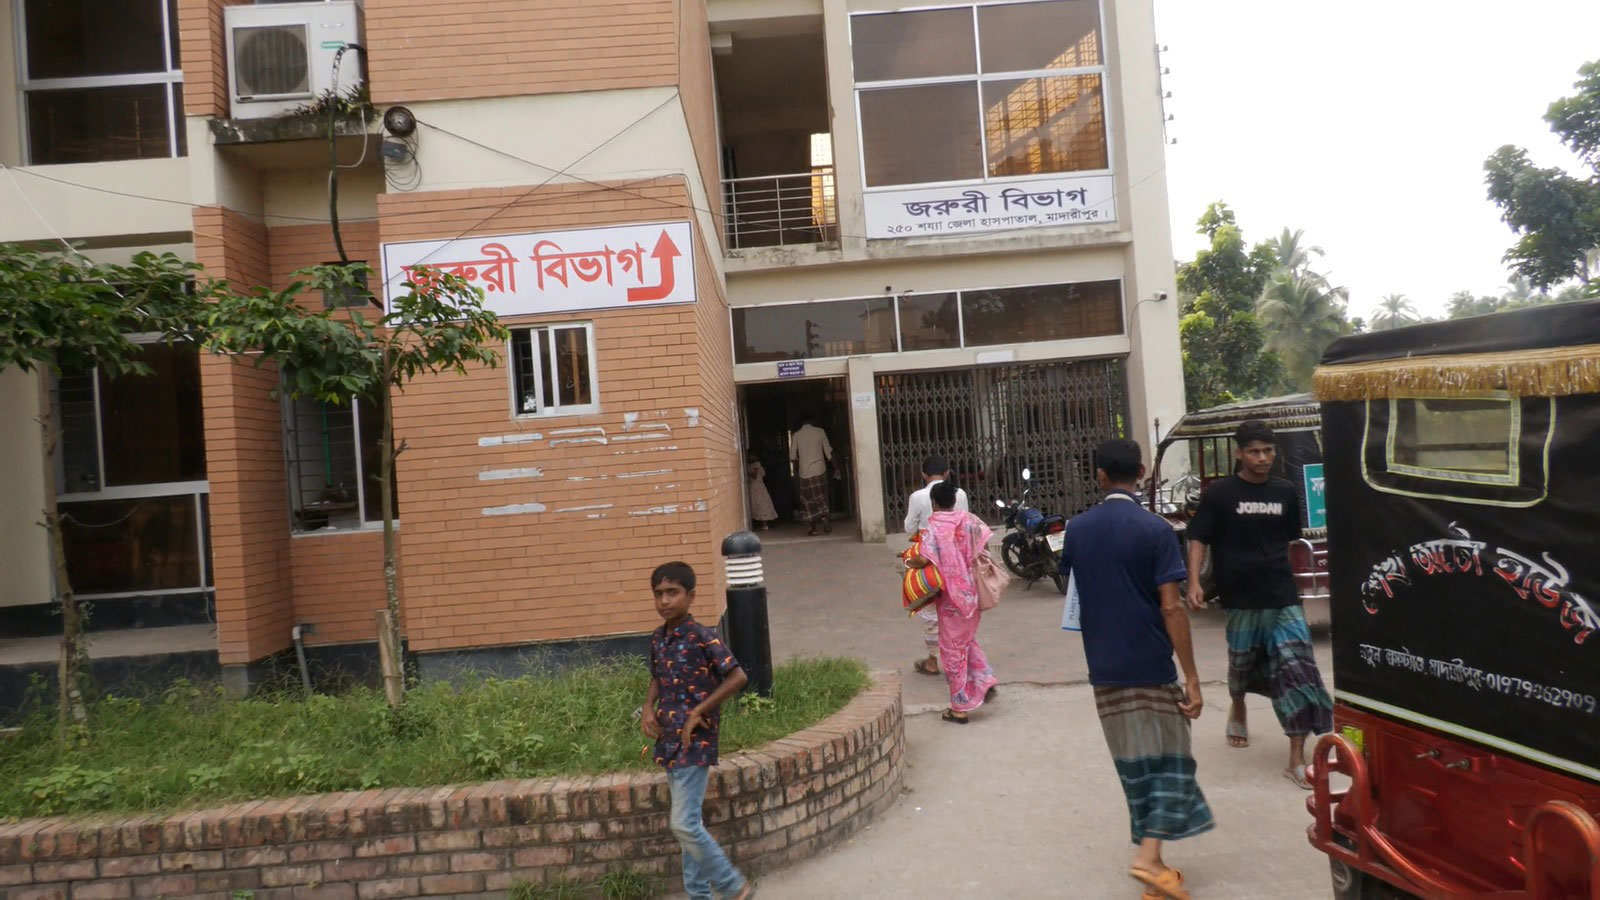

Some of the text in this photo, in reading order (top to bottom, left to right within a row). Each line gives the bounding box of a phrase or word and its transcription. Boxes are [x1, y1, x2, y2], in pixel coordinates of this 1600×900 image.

[902, 186, 1087, 218] জরুরী বিভাগ
[887, 225, 913, 235] ২৫০
[947, 218, 976, 230] জেলা
[528, 240, 648, 291] বিভাগ
[1236, 501, 1283, 515] JORDAN
[1409, 520, 1487, 576] অটো
